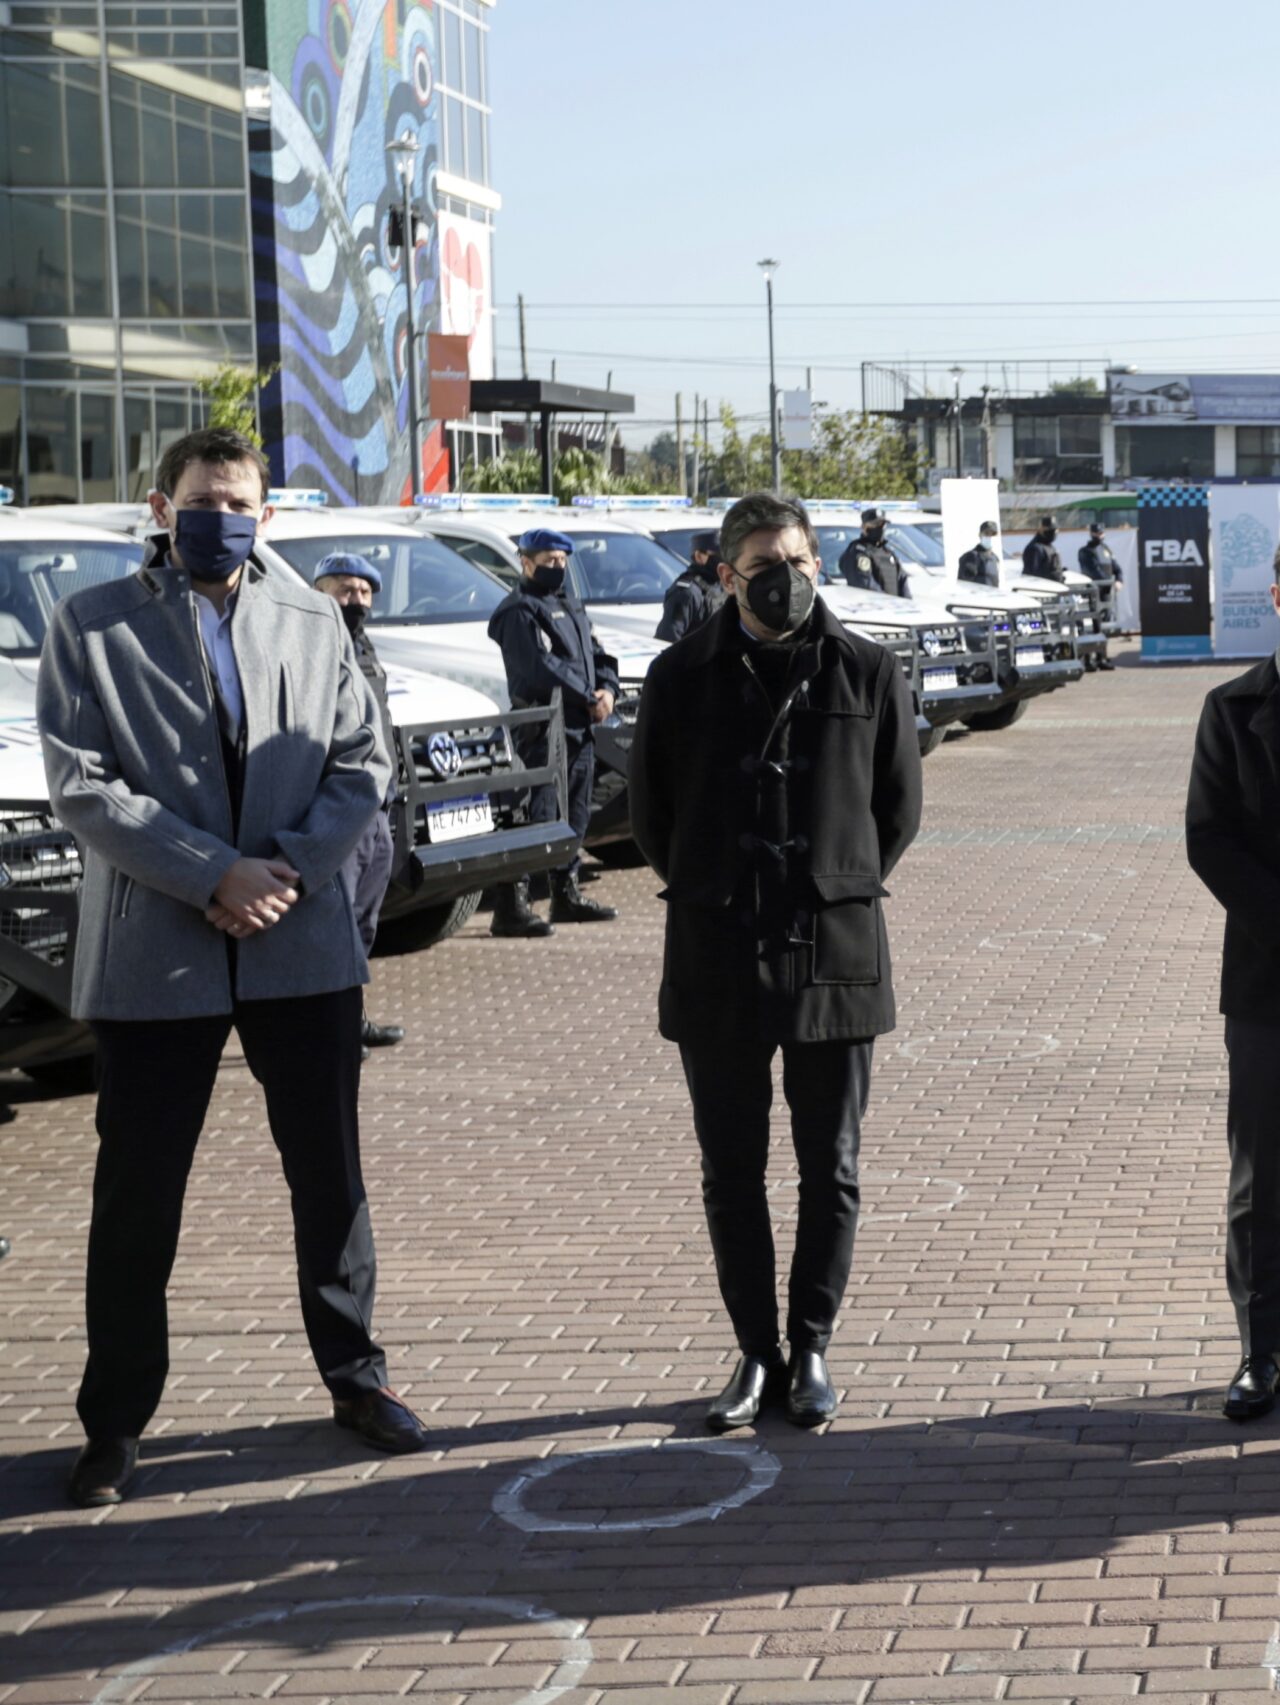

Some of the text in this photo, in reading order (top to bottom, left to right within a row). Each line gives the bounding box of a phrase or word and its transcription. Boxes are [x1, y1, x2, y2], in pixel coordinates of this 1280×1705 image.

[1144, 539, 1204, 568] FBA
[1223, 605, 1276, 616] BUENOS
[1223, 617, 1261, 629] AIRES
[432, 810, 447, 830] AE
[448, 804, 470, 826] 747
